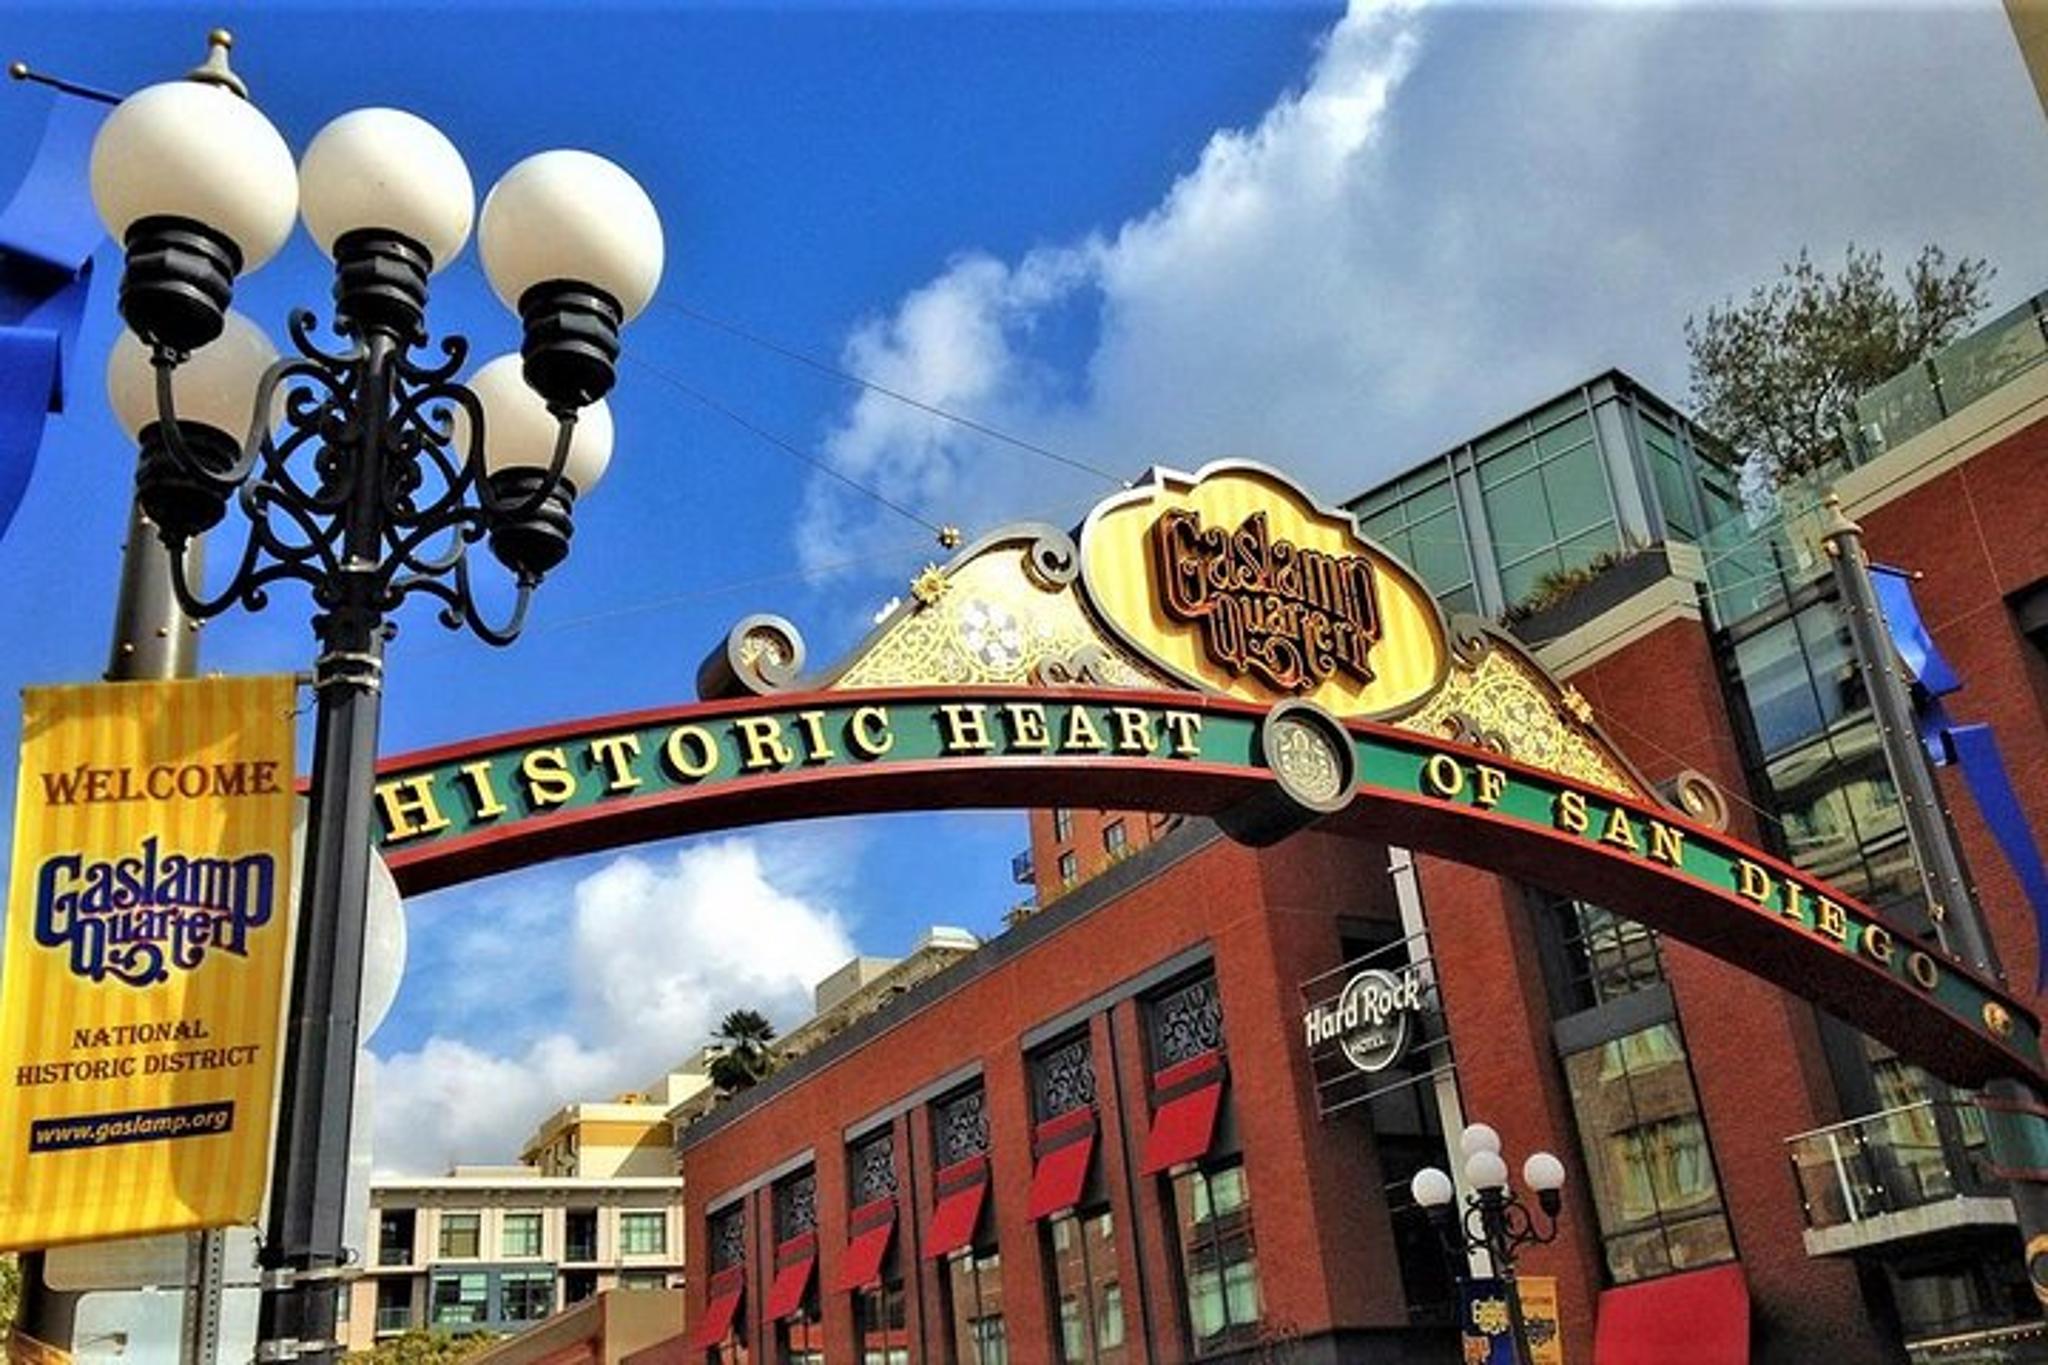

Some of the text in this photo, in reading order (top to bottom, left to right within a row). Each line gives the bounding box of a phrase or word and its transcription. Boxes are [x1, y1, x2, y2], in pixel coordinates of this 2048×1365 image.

[1157, 508, 1381, 645] Gaslamp
[1204, 590, 1376, 690] Quarter
[41, 761, 281, 806] WELCOME
[375, 703, 1939, 989] HISTORIC HEART OF SAN DIEGO
[35, 835, 274, 956] Gaslamp
[70, 905, 245, 987] Quarter
[72, 1020, 208, 1049] NATIONAL
[1304, 970, 1421, 1048] Hard Rock
[17, 1046, 259, 1086] HISTORIC DISTRICT
[36, 1110, 229, 1144] www.gaslamp.org
